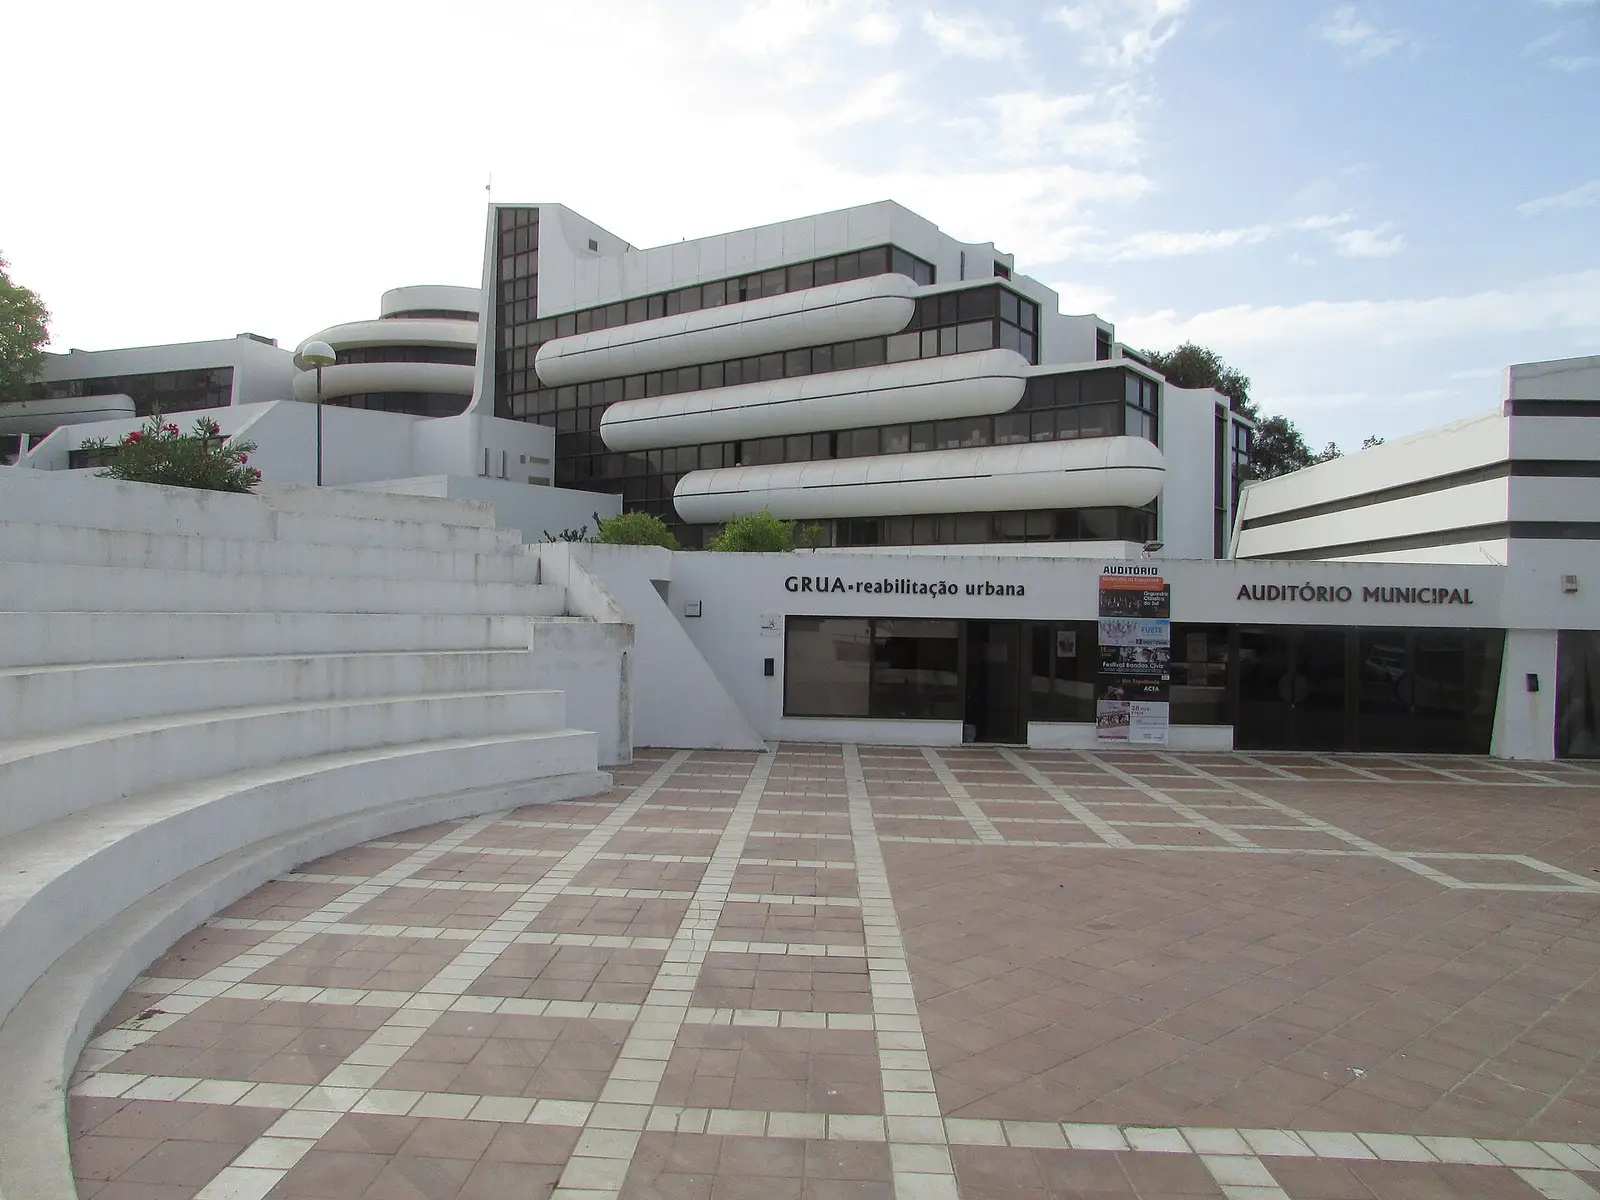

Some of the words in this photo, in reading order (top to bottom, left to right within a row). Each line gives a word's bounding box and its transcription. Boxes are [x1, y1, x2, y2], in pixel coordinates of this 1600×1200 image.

[1103, 565, 1158, 575] AUDITÓRIO
[965, 581, 1025, 596] urbana
[1236, 581, 1352, 602] AUDITÓRIO
[1362, 586, 1473, 604] MUNICIPAL
